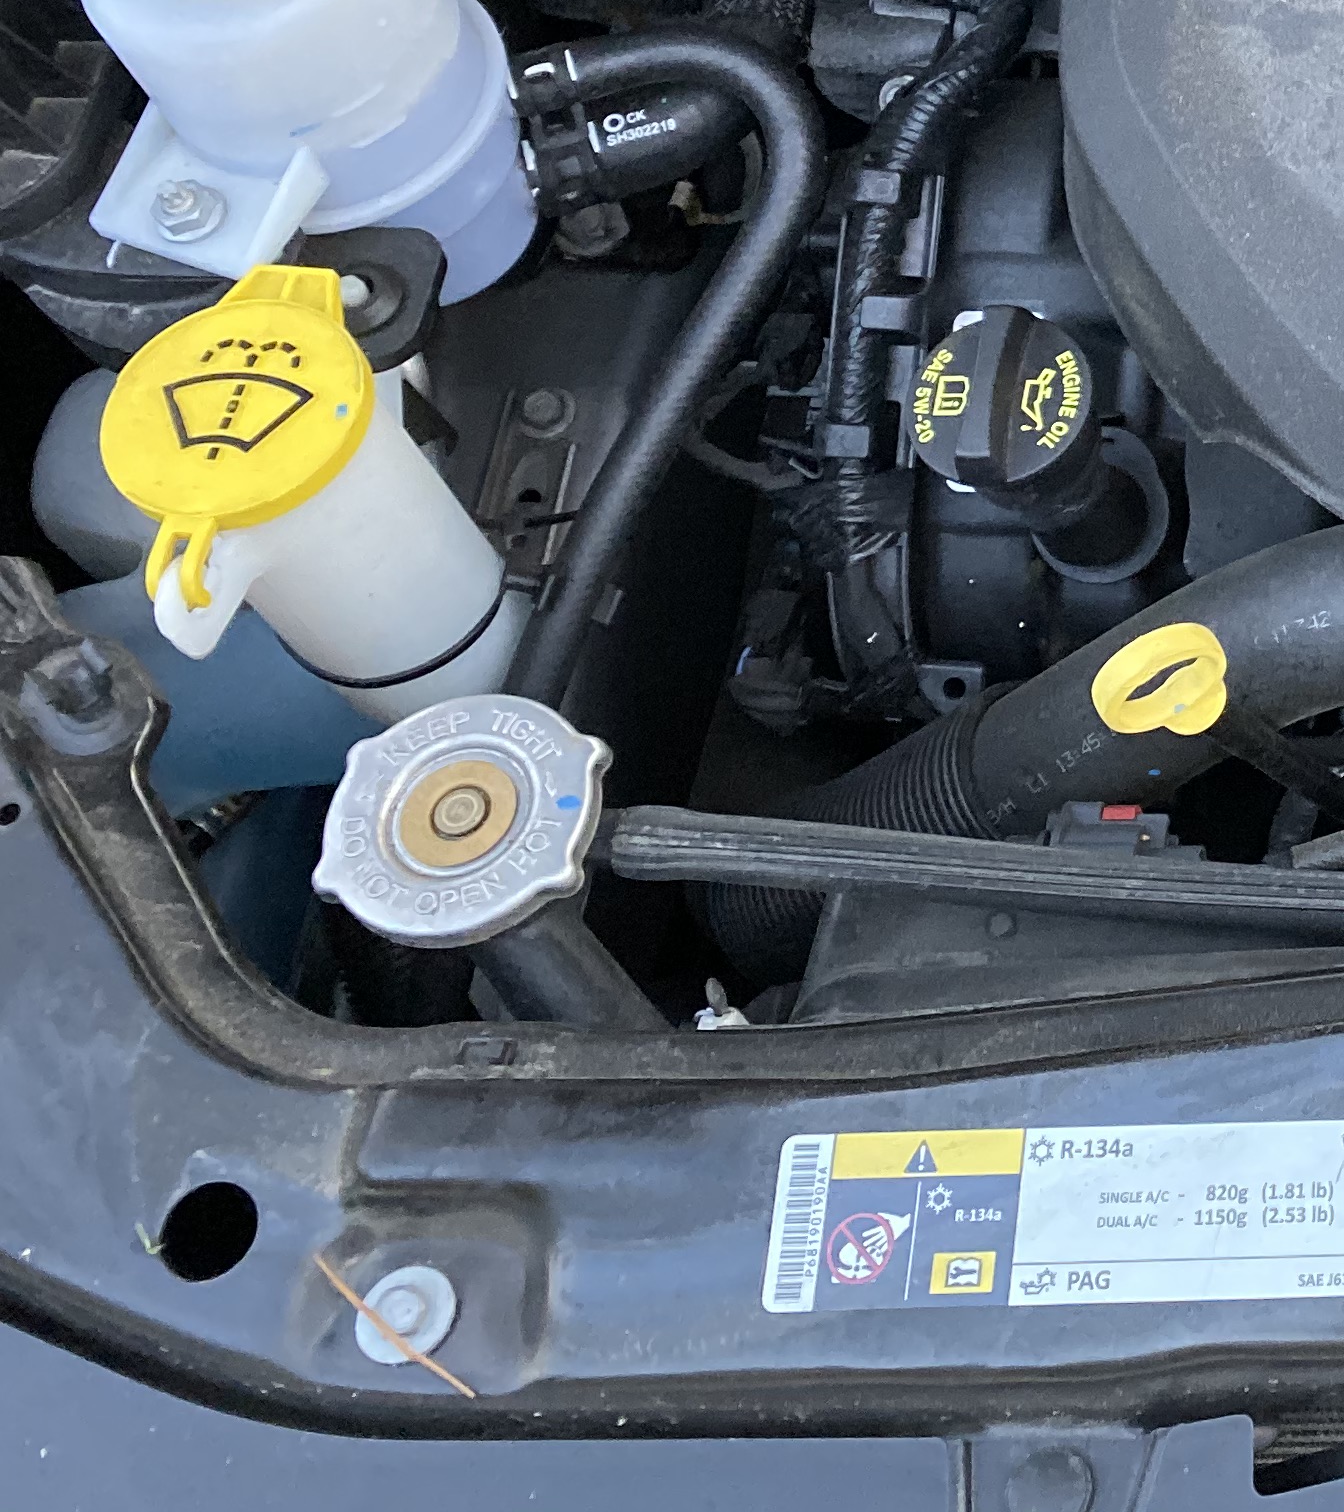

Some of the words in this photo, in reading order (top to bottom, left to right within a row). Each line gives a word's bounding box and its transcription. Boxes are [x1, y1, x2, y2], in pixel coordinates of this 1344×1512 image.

[921, 349, 953, 383] SAE
[1055, 350, 1081, 418] ENGINE
[913, 387, 935, 443] 5W-20
[1037, 421, 1069, 449] OIL
[380, 710, 470, 766] KEEP
[490, 708, 562, 760] TIGHT
[341, 817, 367, 857] DO
[356, 863, 410, 906] NOT
[414, 873, 507, 915] OPEN
[508, 817, 561, 876] HOT
[1060, 1138, 1134, 1161] R-134a
[1099, 1190, 1147, 1205] SINGLE
[1149, 1189, 1170, 1204] A/C
[1205, 1185, 1248, 1205] 820g
[1261, 1182, 1305, 1202] (1.81
[1309, 1182, 1335, 1202] lb)
[954, 1208, 1002, 1222] R-134a
[1097, 1216, 1130, 1230] DUAL
[1134, 1215, 1158, 1229] A/C
[1194, 1208, 1247, 1228] 1150g
[1261, 1206, 1306, 1226] (2.53
[1310, 1205, 1335, 1225] lb)
[1067, 1270, 1111, 1292] PAG
[1299, 1273, 1324, 1288] SAE
